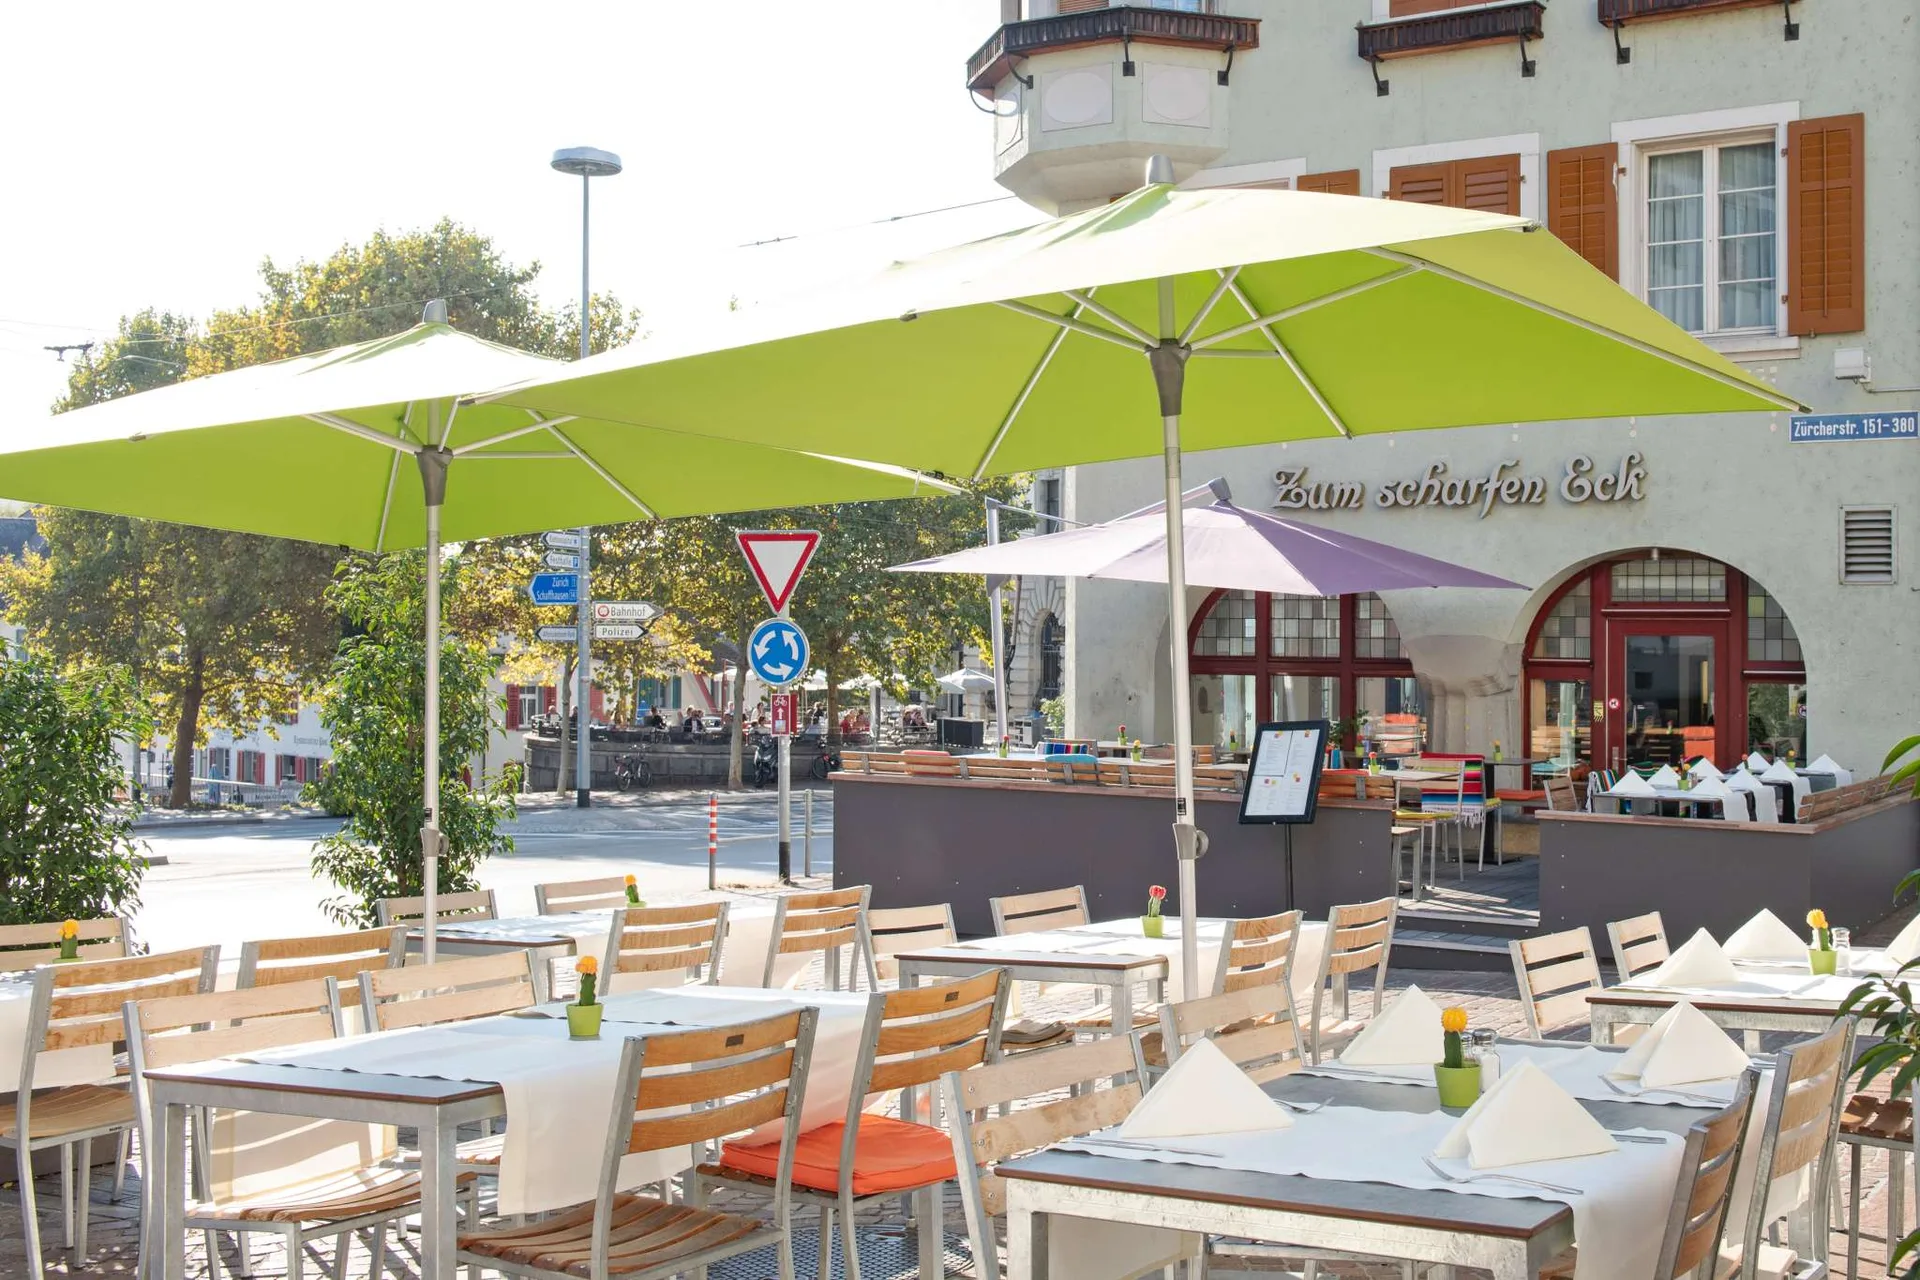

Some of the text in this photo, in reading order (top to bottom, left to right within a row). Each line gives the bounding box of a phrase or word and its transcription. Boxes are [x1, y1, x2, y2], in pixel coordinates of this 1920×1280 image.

[1794, 417, 1915, 437] Zürcherstr. 151-380
[1271, 451, 1648, 519] Zum scharfen Eck
[552, 577, 569, 587] Zürich
[536, 590, 569, 600] Schaffhausen
[611, 606, 645, 617] Bahnhof
[602, 627, 633, 636] Polizei
